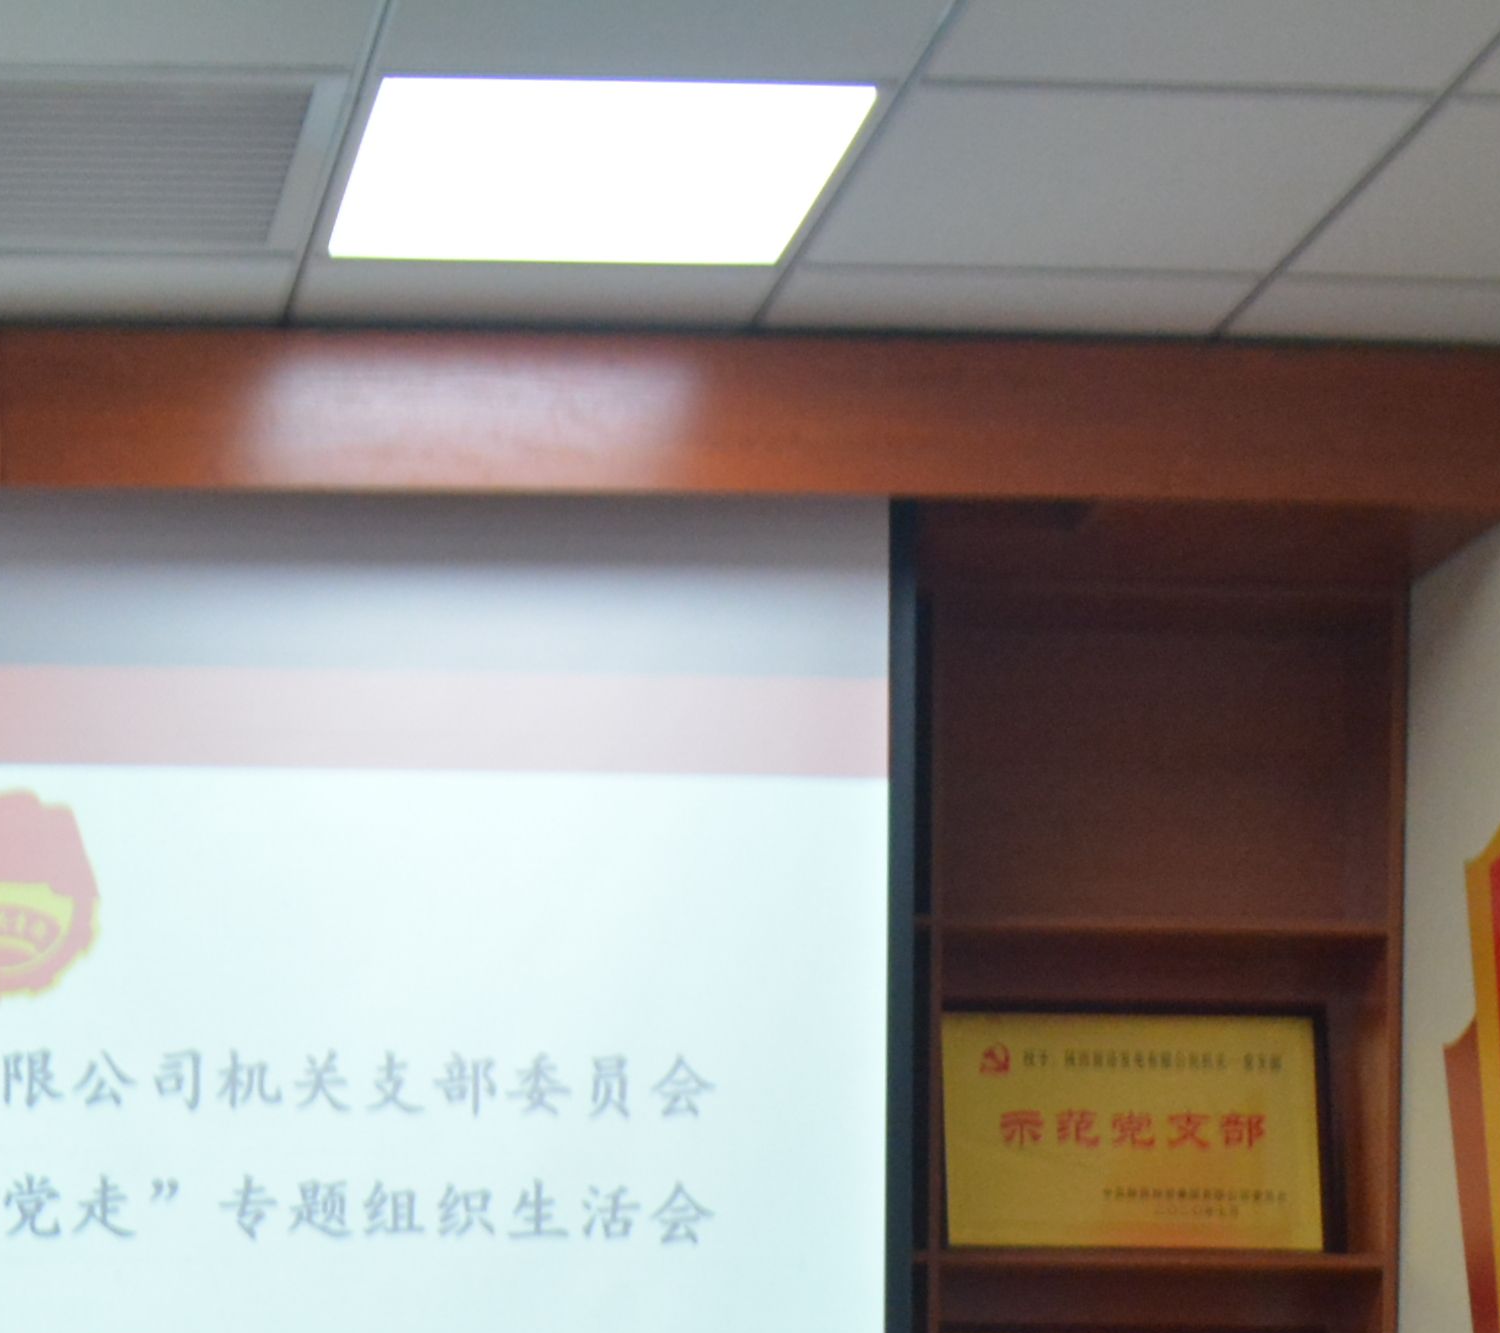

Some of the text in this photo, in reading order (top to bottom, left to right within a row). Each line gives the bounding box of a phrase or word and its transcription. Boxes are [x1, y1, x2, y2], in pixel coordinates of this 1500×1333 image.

[1000, 1108, 1266, 1150] 示范党支部
